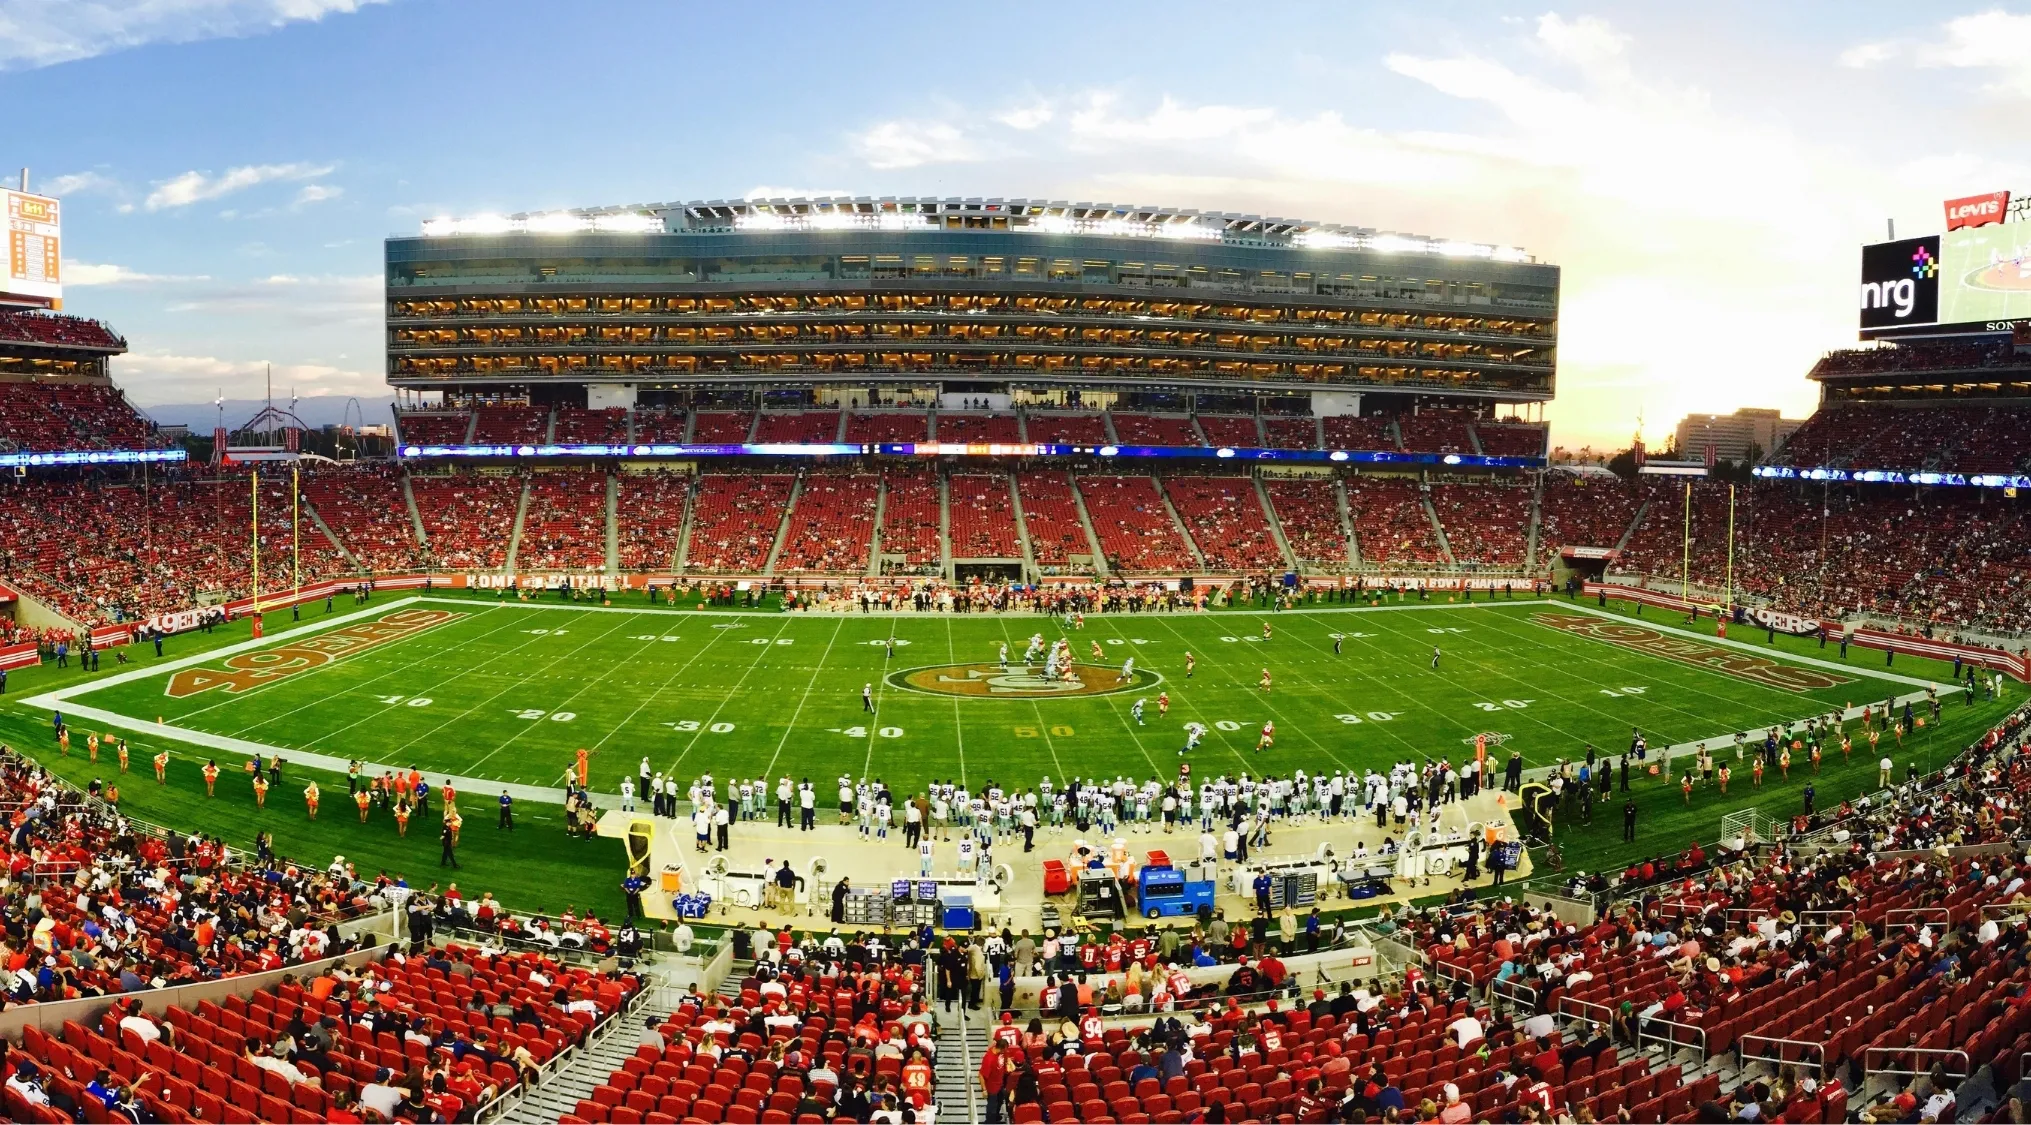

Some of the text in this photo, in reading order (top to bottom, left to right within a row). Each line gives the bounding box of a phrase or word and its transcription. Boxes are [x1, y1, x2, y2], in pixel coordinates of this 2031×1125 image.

[1861, 278, 1915, 317] nrg
[1986, 321, 2015, 331] SON
[1429, 578, 1461, 588] BOWL
[1465, 578, 1532, 588] CHAMPIONS
[164, 608, 473, 698] 49ERS
[1527, 612, 1861, 692] 49ERS
[1600, 687, 1644, 697] 10
[382, 695, 433, 707] 10
[1473, 700, 1528, 712] 20
[517, 709, 576, 722] 20
[1335, 711, 1393, 724] 30
[673, 721, 735, 733] 30
[843, 726, 904, 738] 40
[1014, 727, 1074, 738] 50
[1321, 788, 1330, 796] 27
[922, 845, 929, 854] 11
[961, 844, 971, 853] 32
[620, 930, 634, 942] 54
[830, 947, 838, 958] 9
[990, 944, 1000, 955] 24
[1063, 944, 1075, 955] 88
[1085, 952, 1094, 963] 11
[1175, 980, 1191, 996] 16
[1084, 1020, 1103, 1039] 94
[908, 1072, 926, 1087] 49
[1538, 1090, 1551, 1111] 7
